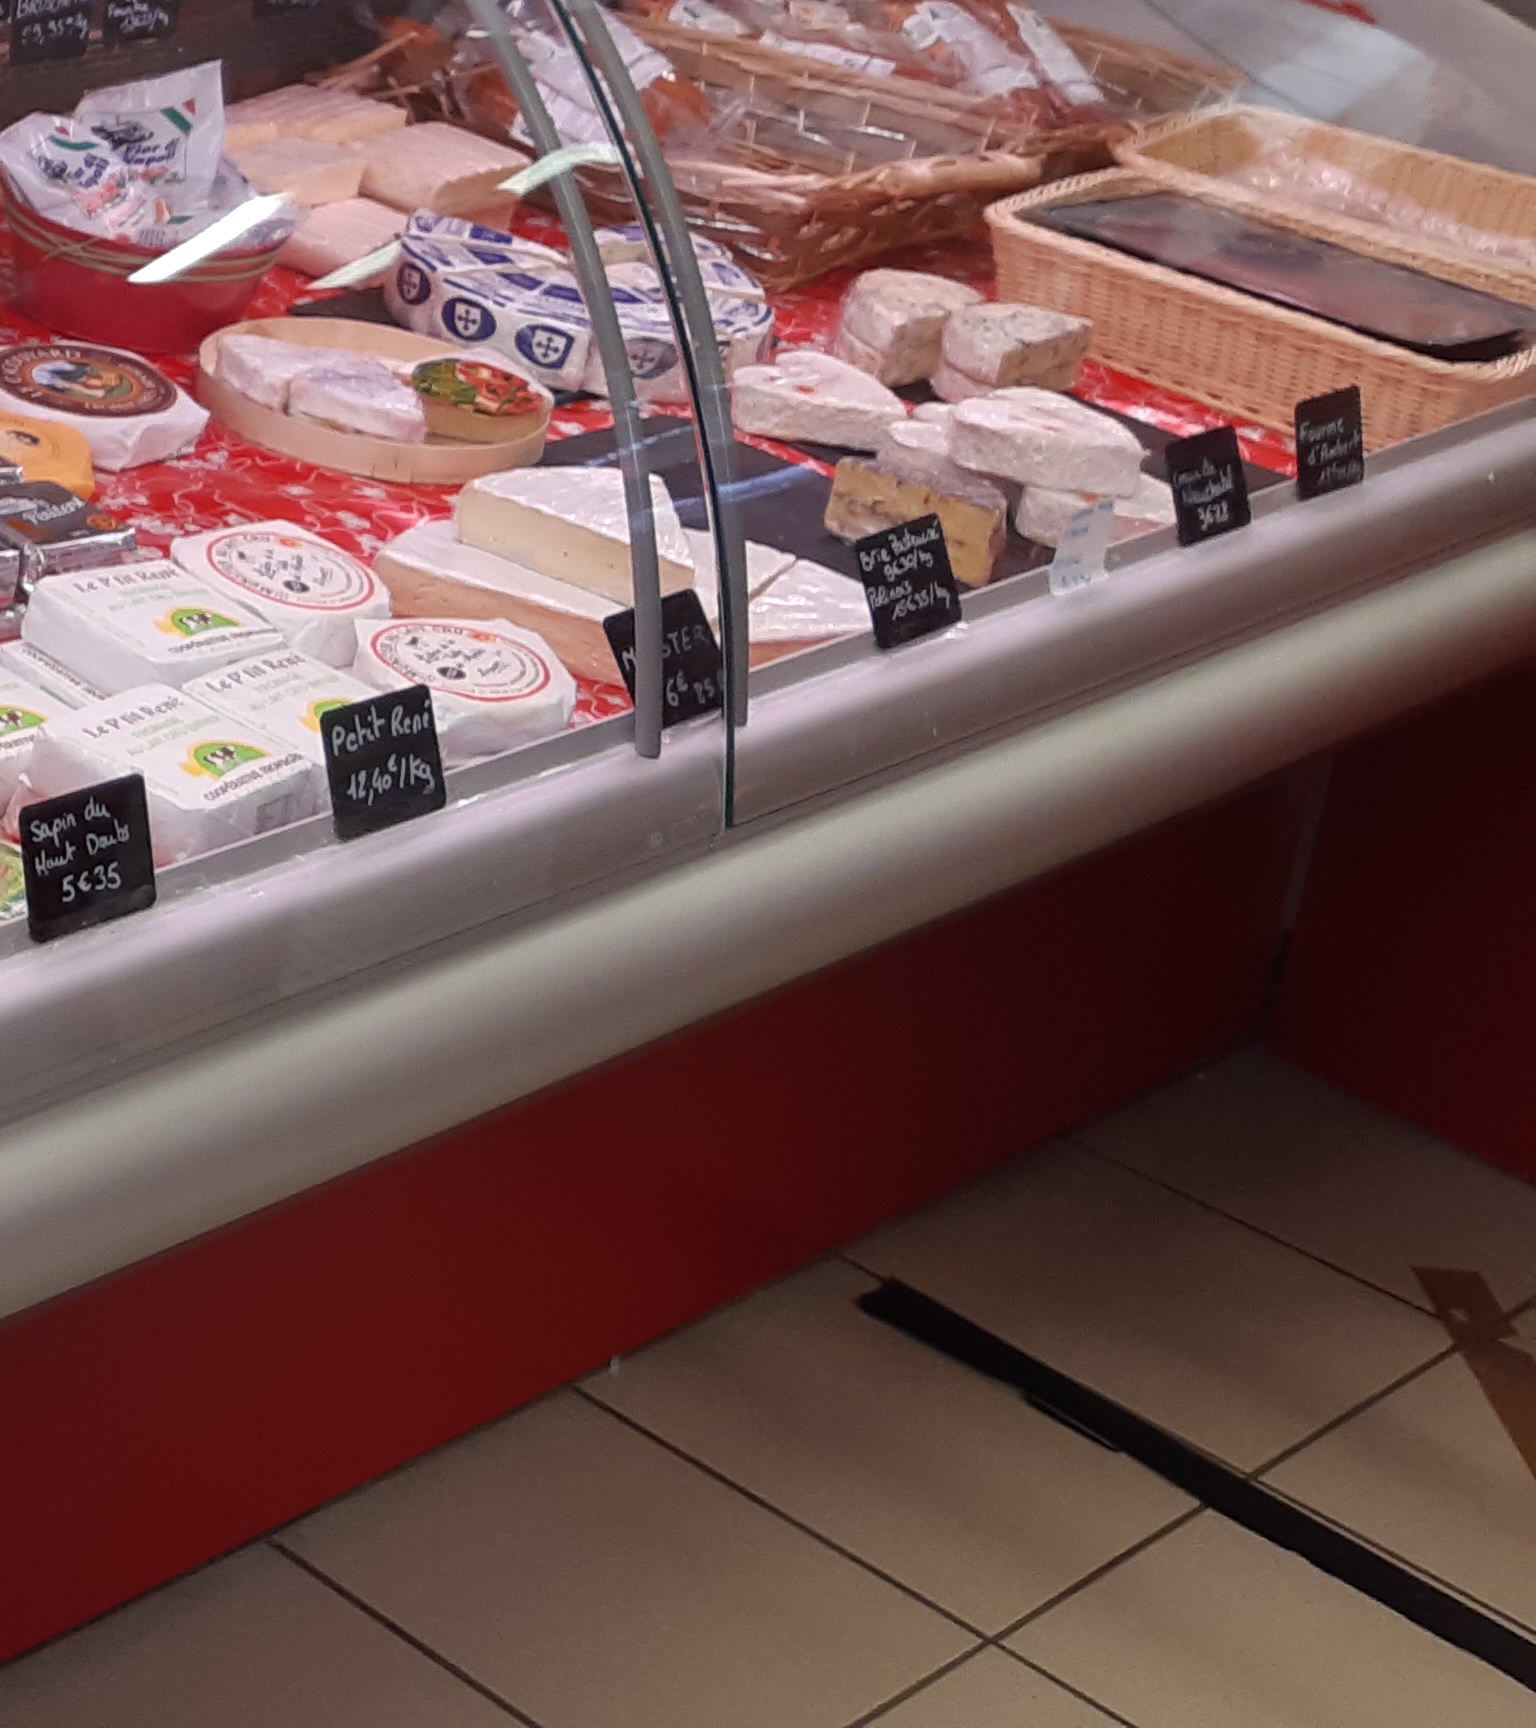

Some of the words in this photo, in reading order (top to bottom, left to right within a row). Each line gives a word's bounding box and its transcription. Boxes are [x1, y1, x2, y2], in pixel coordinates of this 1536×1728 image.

[73, 579, 98, 594] Le
[205, 677, 229, 693] Le
[81, 722, 108, 740] Le
[330, 715, 386, 758] Petit
[390, 698, 435, 739] René
[30, 812, 78, 844] Sapin
[84, 796, 111, 821] du
[34, 844, 78, 878] Haut
[60, 861, 123, 904] 5€35
